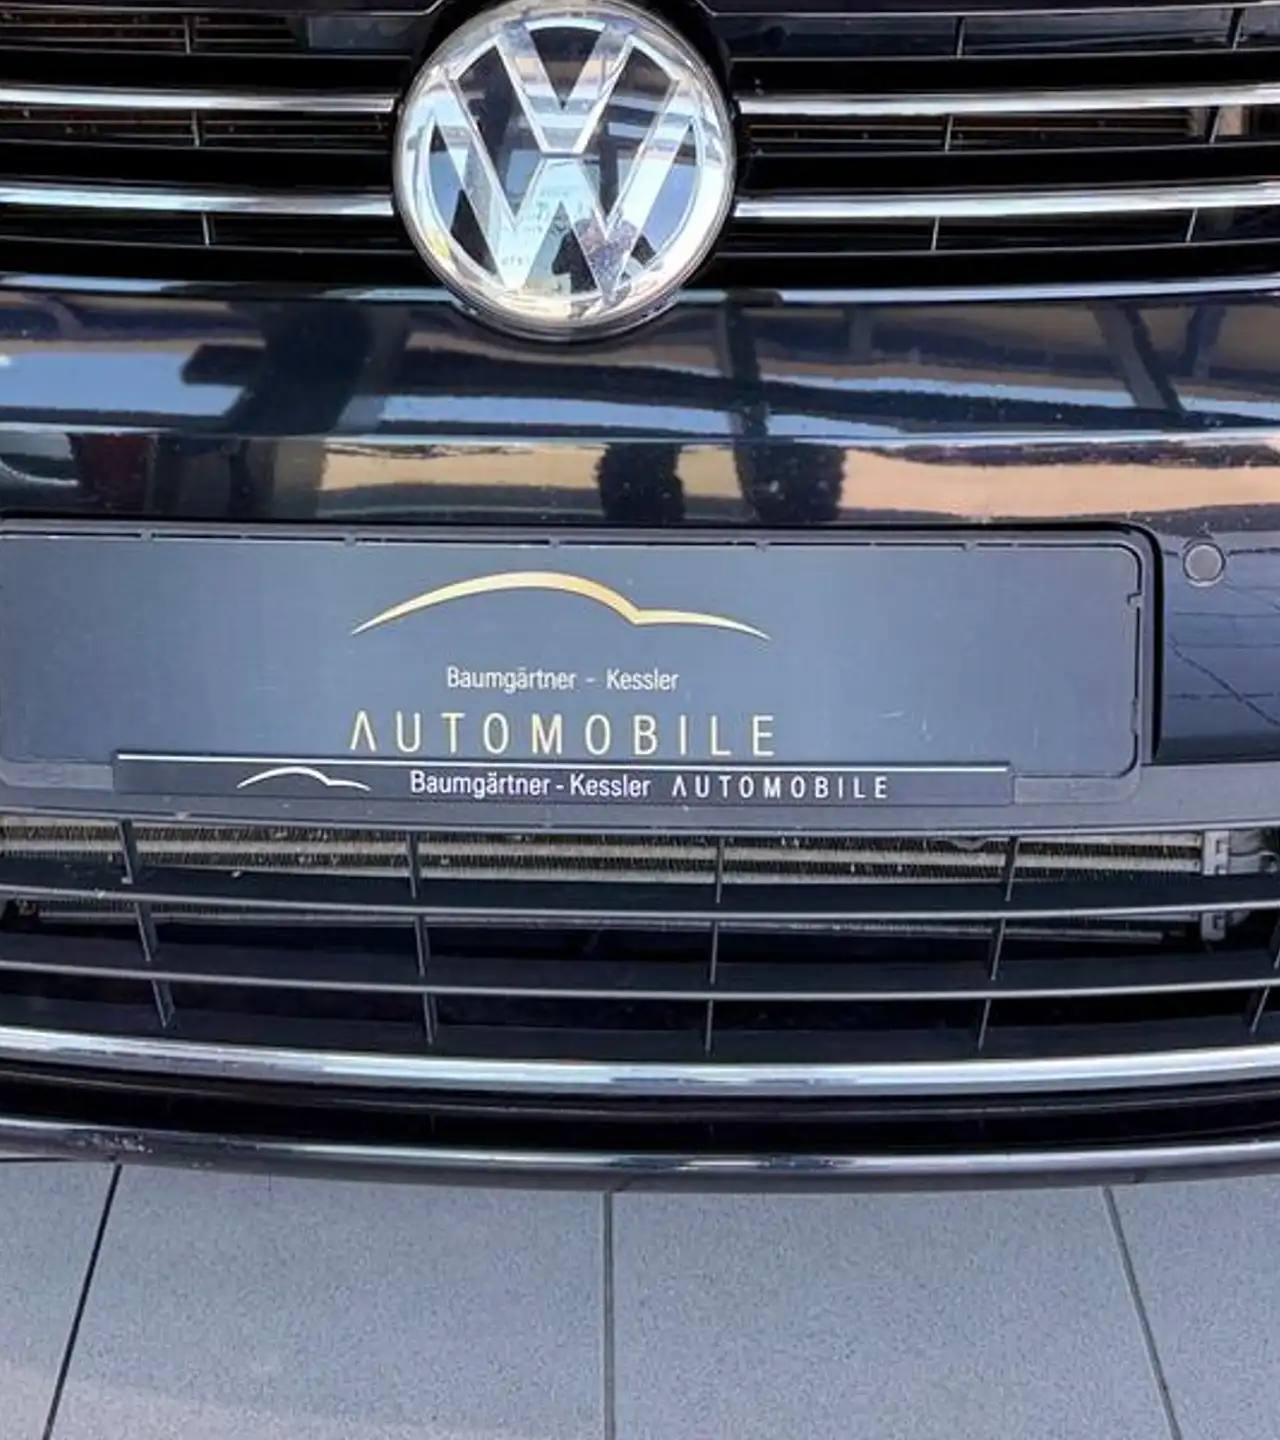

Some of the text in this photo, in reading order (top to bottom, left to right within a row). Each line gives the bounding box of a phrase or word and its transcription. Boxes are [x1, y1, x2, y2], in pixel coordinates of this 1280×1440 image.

[404, 0, 726, 325] VW
[447, 666, 577, 694] Baumgärtner
[606, 668, 679, 692] Kessler
[349, 710, 776, 758] AUTOMOBILE
[410, 770, 551, 799] Baumgärtner
[570, 773, 651, 797] Kessler
[671, 774, 888, 799] AUTOMOBILE
